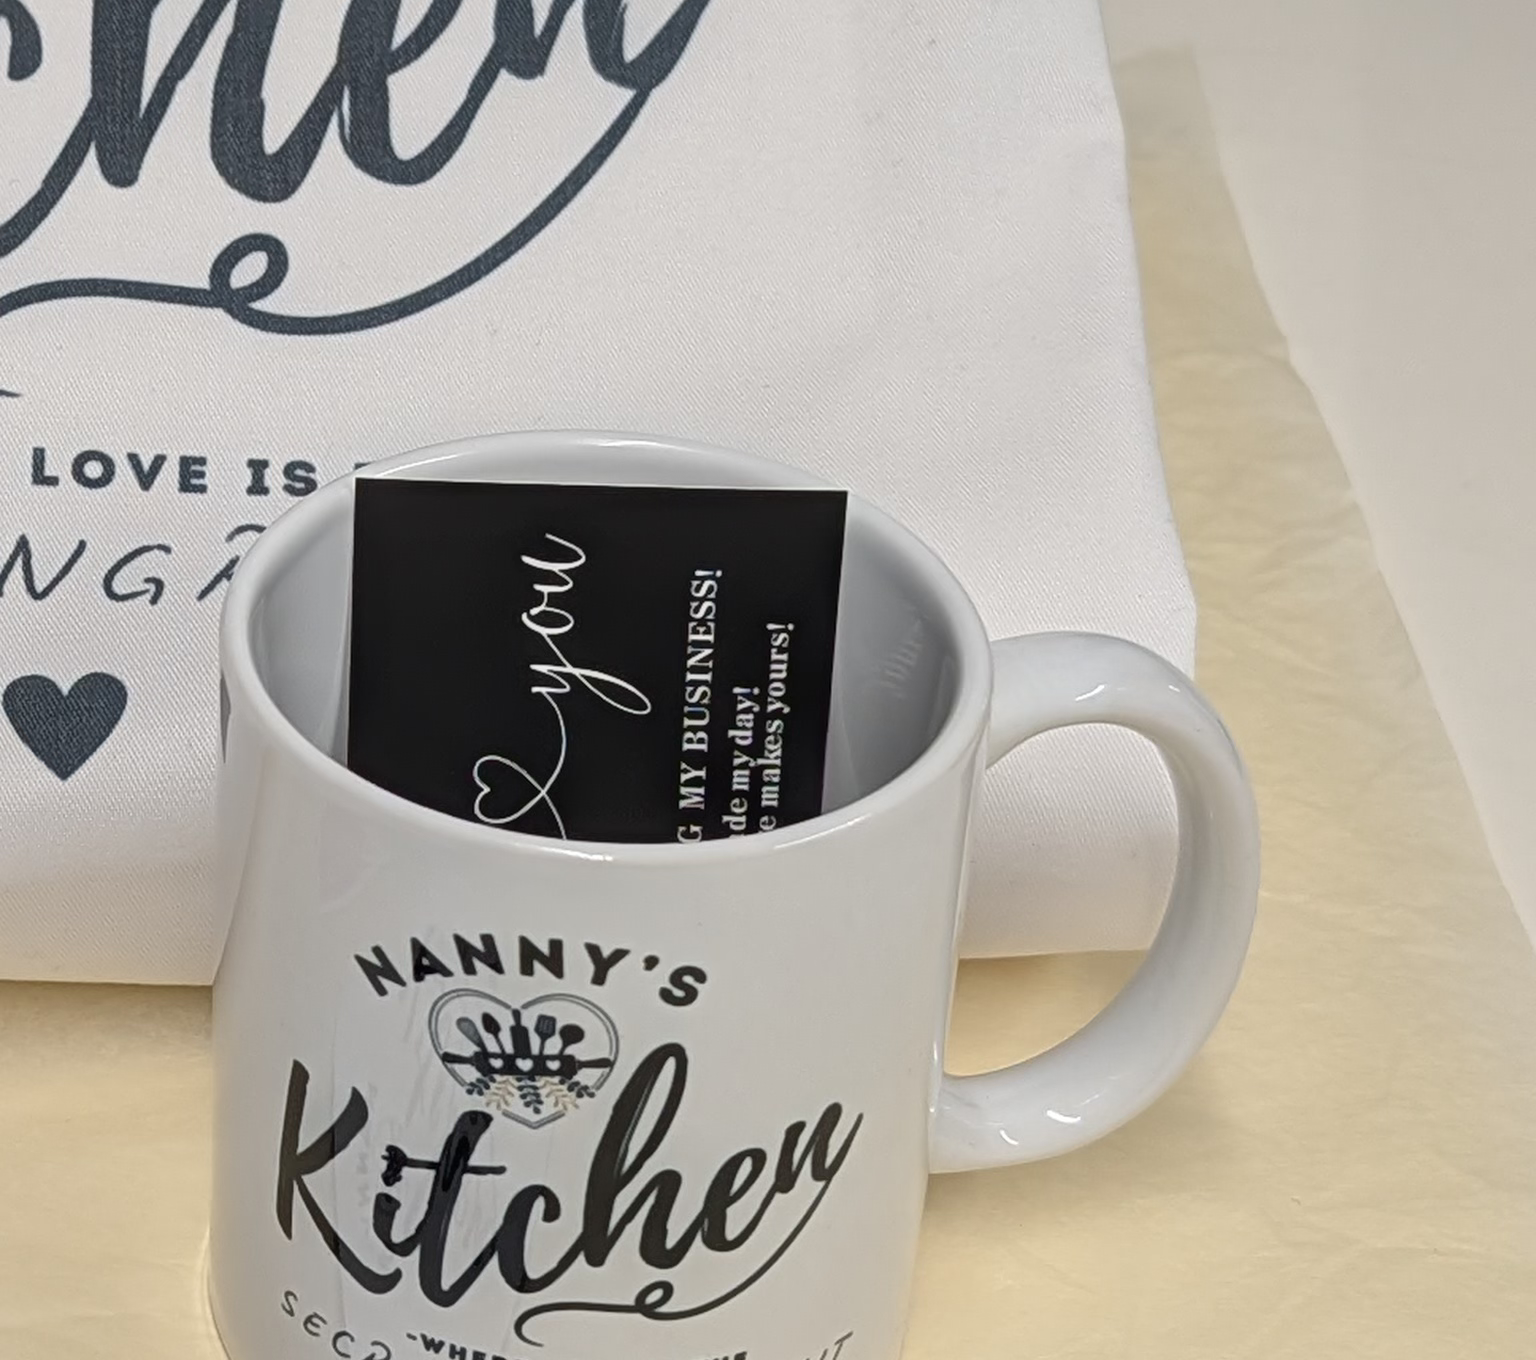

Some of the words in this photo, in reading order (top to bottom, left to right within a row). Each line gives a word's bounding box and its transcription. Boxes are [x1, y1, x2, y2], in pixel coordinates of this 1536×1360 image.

[32, 448, 208, 495] LOVE
[246, 459, 318, 497] IS
[520, 532, 652, 716] you
[682, 569, 723, 753] BUSINESS!
[765, 622, 795, 714] yours!
[727, 686, 760, 746] day!
[678, 761, 706, 810] MY
[732, 750, 756, 791] my
[757, 719, 784, 807] makes
[722, 797, 748, 836] de
[353, 933, 707, 1007] NANNY'S
[276, 1042, 863, 1347] Kitchen
